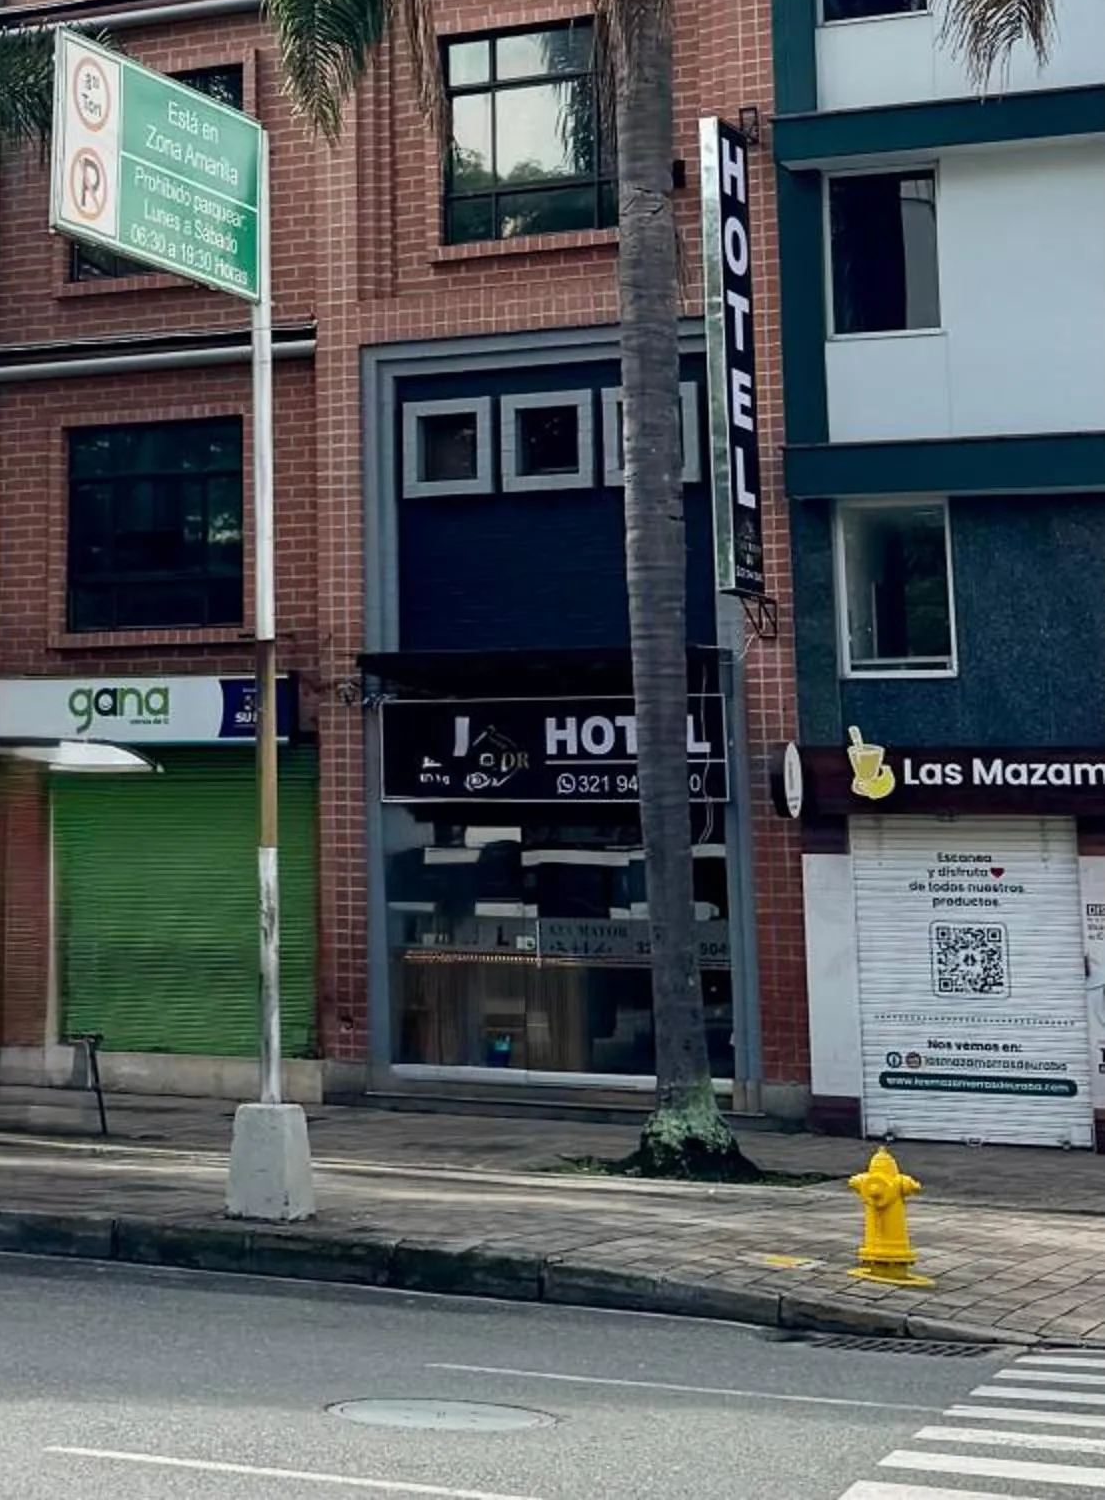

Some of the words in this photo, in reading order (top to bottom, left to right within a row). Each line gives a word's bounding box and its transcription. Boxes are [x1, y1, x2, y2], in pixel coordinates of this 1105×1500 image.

[168, 100, 198, 135] Está
[202, 122, 219, 144] en
[145, 123, 183, 161] Zona
[184, 143, 239, 186] Amarilla
[134, 165, 192, 207] Prohibido
[194, 195, 246, 228] parquear
[144, 198, 180, 232] Lunes
[182, 220, 193, 236] a
[130, 223, 166, 253] 06:30
[168, 242, 176, 259] a
[721, 137, 756, 509] HOTEL
[68, 687, 169, 735] gana
[546, 715, 712, 756] HOTL
[578, 775, 610, 792] 321
[903, 757, 964, 786] Las
[927, 868, 935, 878] y
[938, 866, 988, 877] disfruta
[937, 851, 992, 863] Escanea
[909, 881, 925, 891] de
[928, 881, 965, 892] todos
[968, 882, 1024, 893] nuestros
[927, 1039, 952, 1050] Nos
[955, 1041, 999, 1052] vemos
[1002, 1043, 1023, 1053] en:
